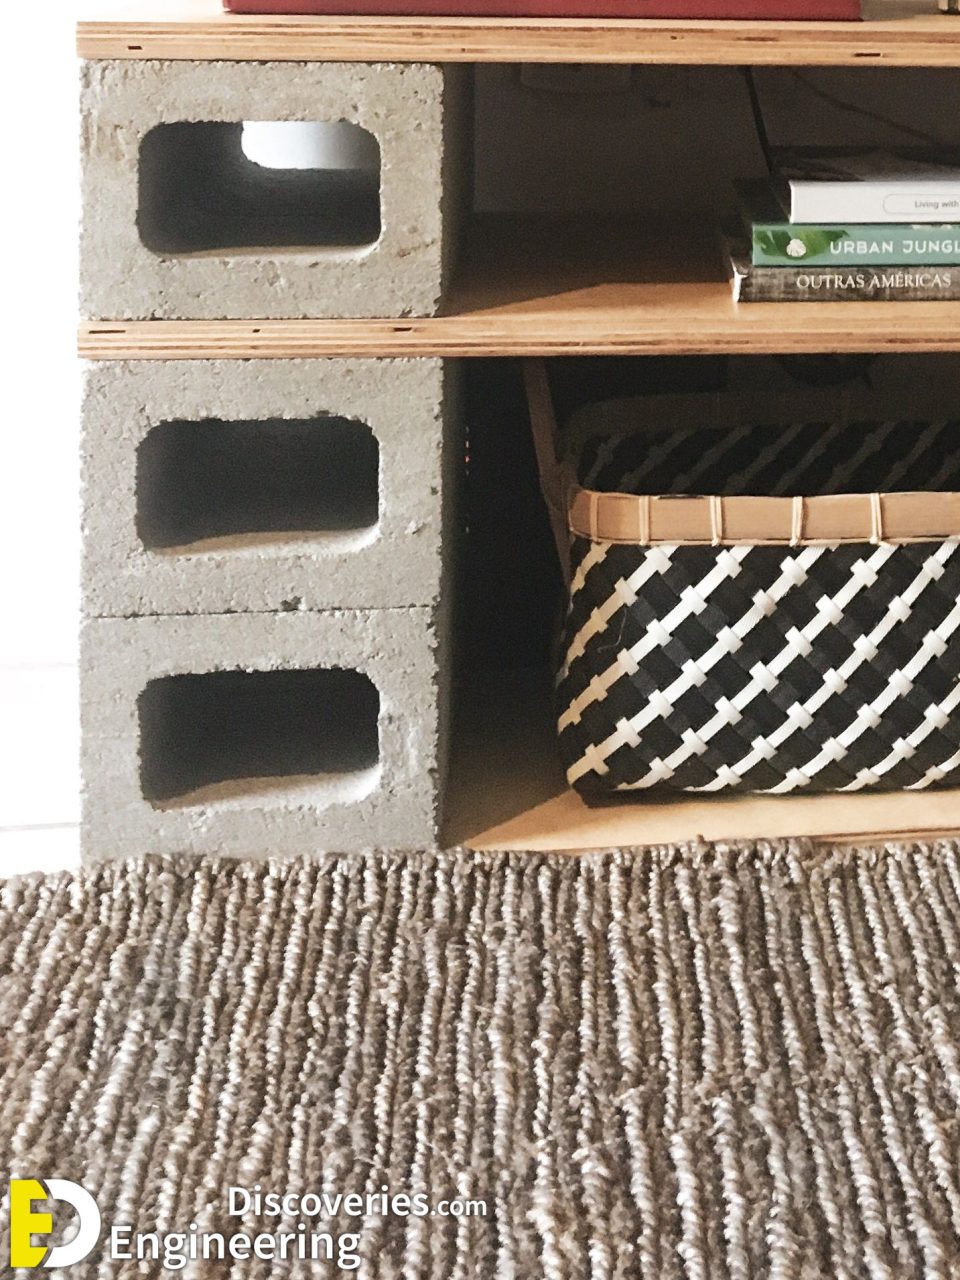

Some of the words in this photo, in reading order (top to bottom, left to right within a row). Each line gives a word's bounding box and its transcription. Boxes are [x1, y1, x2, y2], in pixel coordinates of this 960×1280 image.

[942, 200, 959, 208] with
[829, 241, 893, 255] URBAN
[796, 275, 864, 289] OUTRAS
[868, 272, 951, 288] AMÉRICAS
